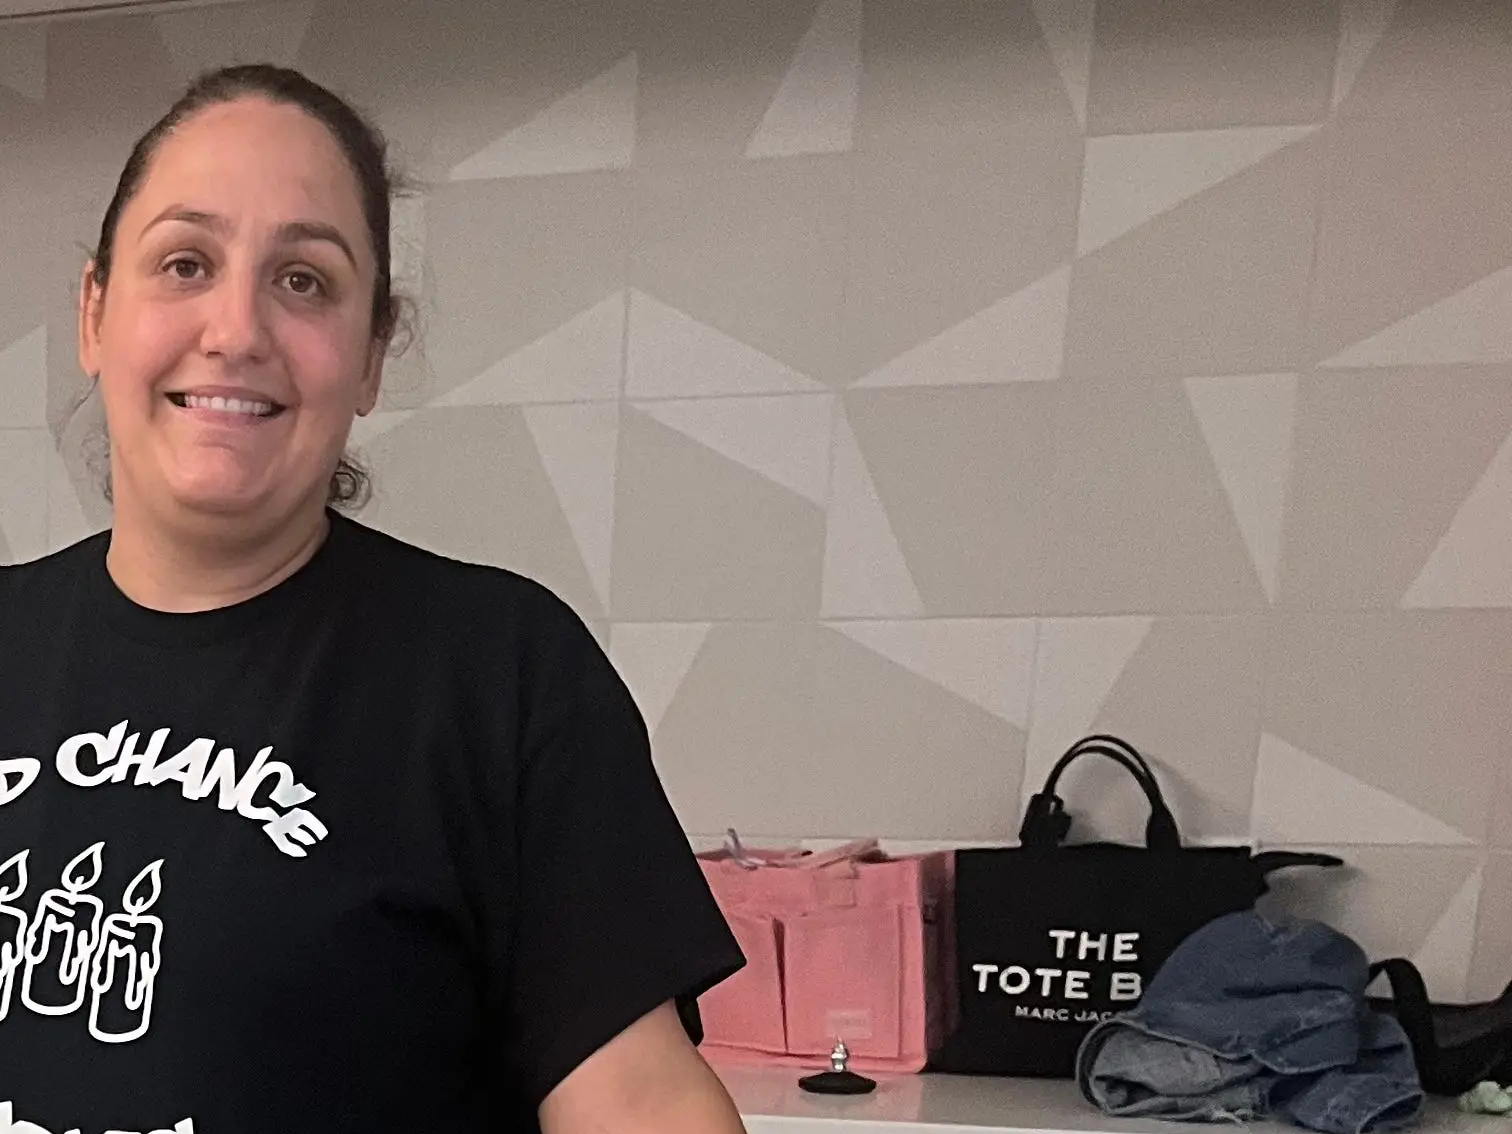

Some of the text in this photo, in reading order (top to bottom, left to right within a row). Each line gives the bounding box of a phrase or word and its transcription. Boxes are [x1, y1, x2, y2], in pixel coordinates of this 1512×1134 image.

[56, 720, 329, 857] CHANCE
[1048, 929, 1139, 962] THE
[972, 964, 1090, 1000] TOTE
[1015, 1005, 1069, 1021] MARC
